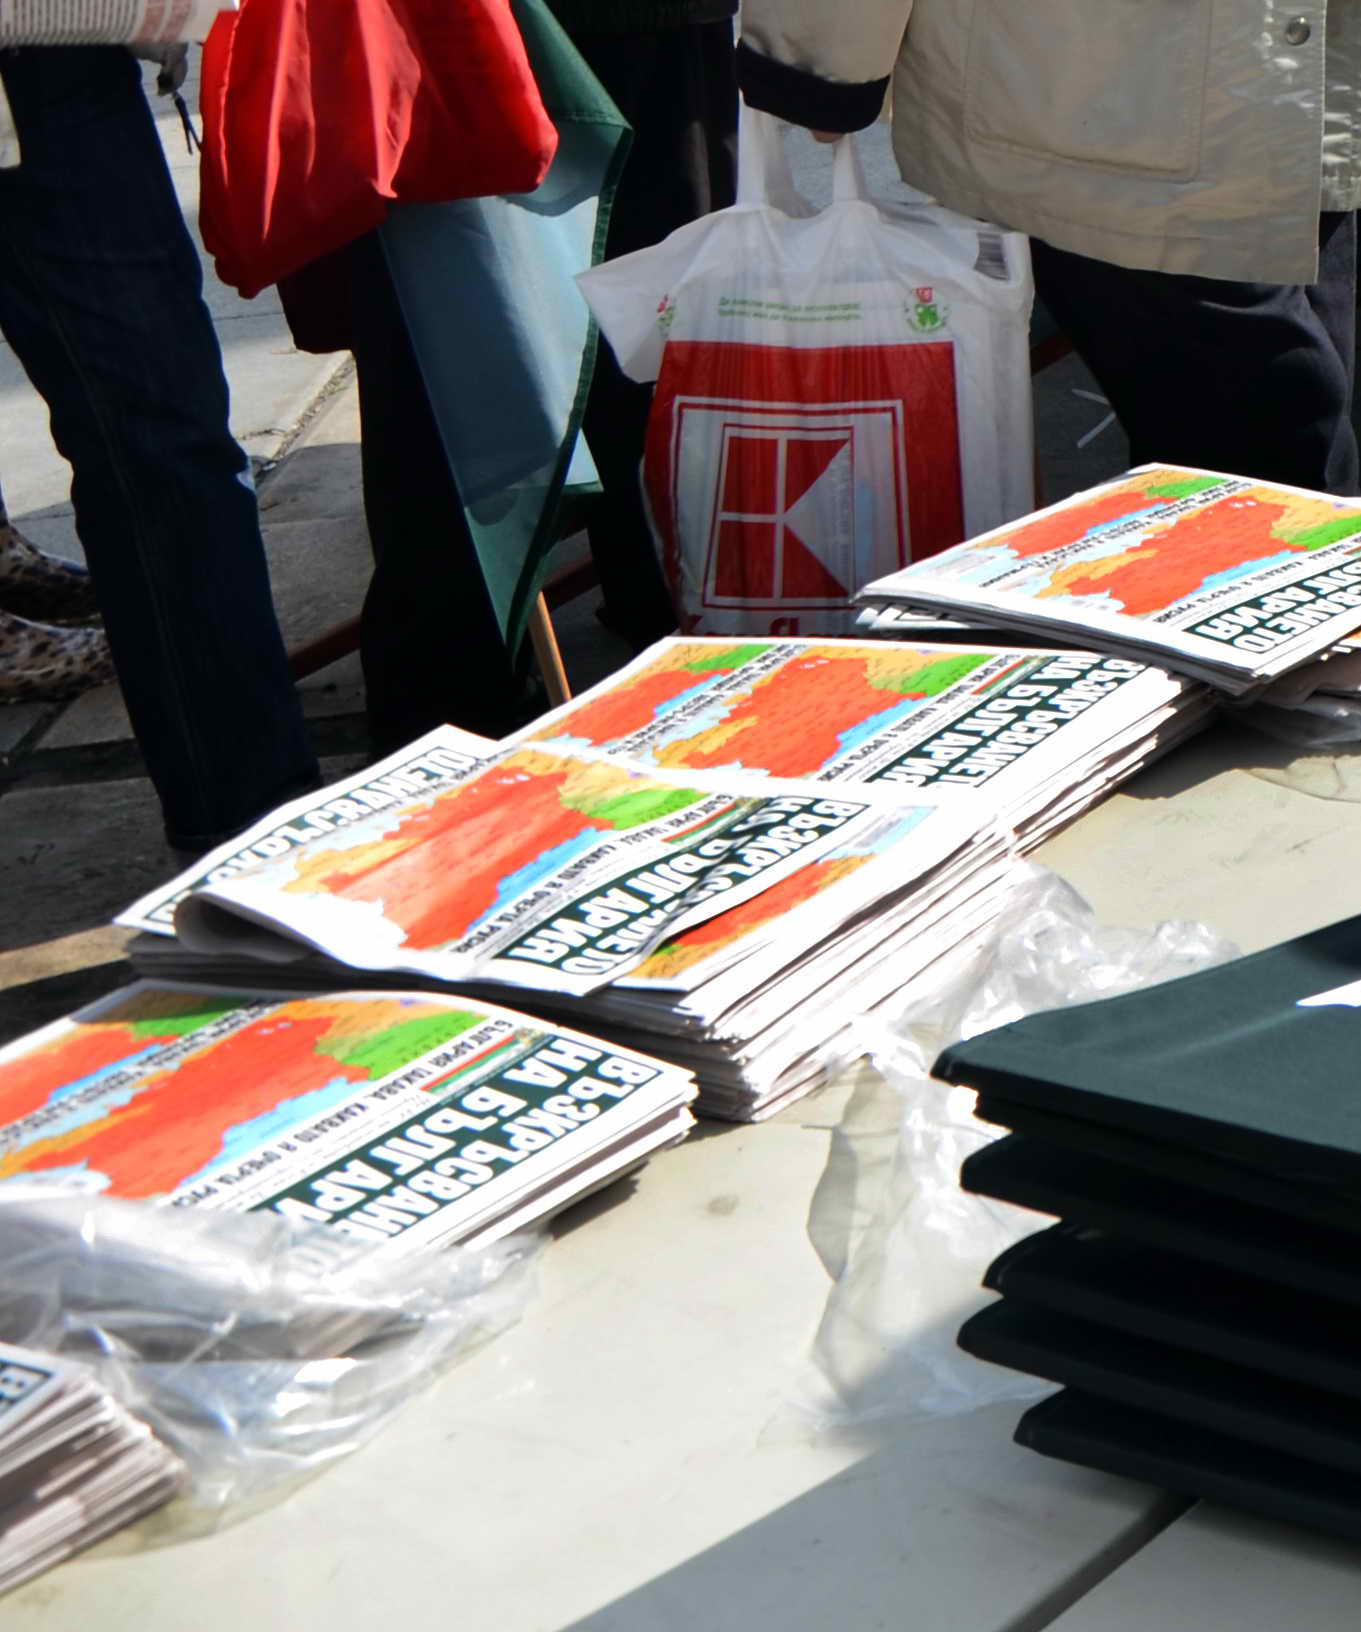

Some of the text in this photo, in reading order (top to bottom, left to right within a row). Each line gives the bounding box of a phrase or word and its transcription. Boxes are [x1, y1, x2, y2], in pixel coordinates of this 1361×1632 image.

[938, 658, 1147, 787] ВЪЗКРЪСВАНЕТ
[1031, 654, 1101, 681] НА
[507, 832, 752, 965] БЪЛГАРИЯ
[429, 1020, 513, 1069] БЪЛГАРИЯ
[276, 1039, 604, 1224] НА БЪЛГАРИ
[312, 1056, 659, 1266] ВЪЗКРЪСВАНЕ
